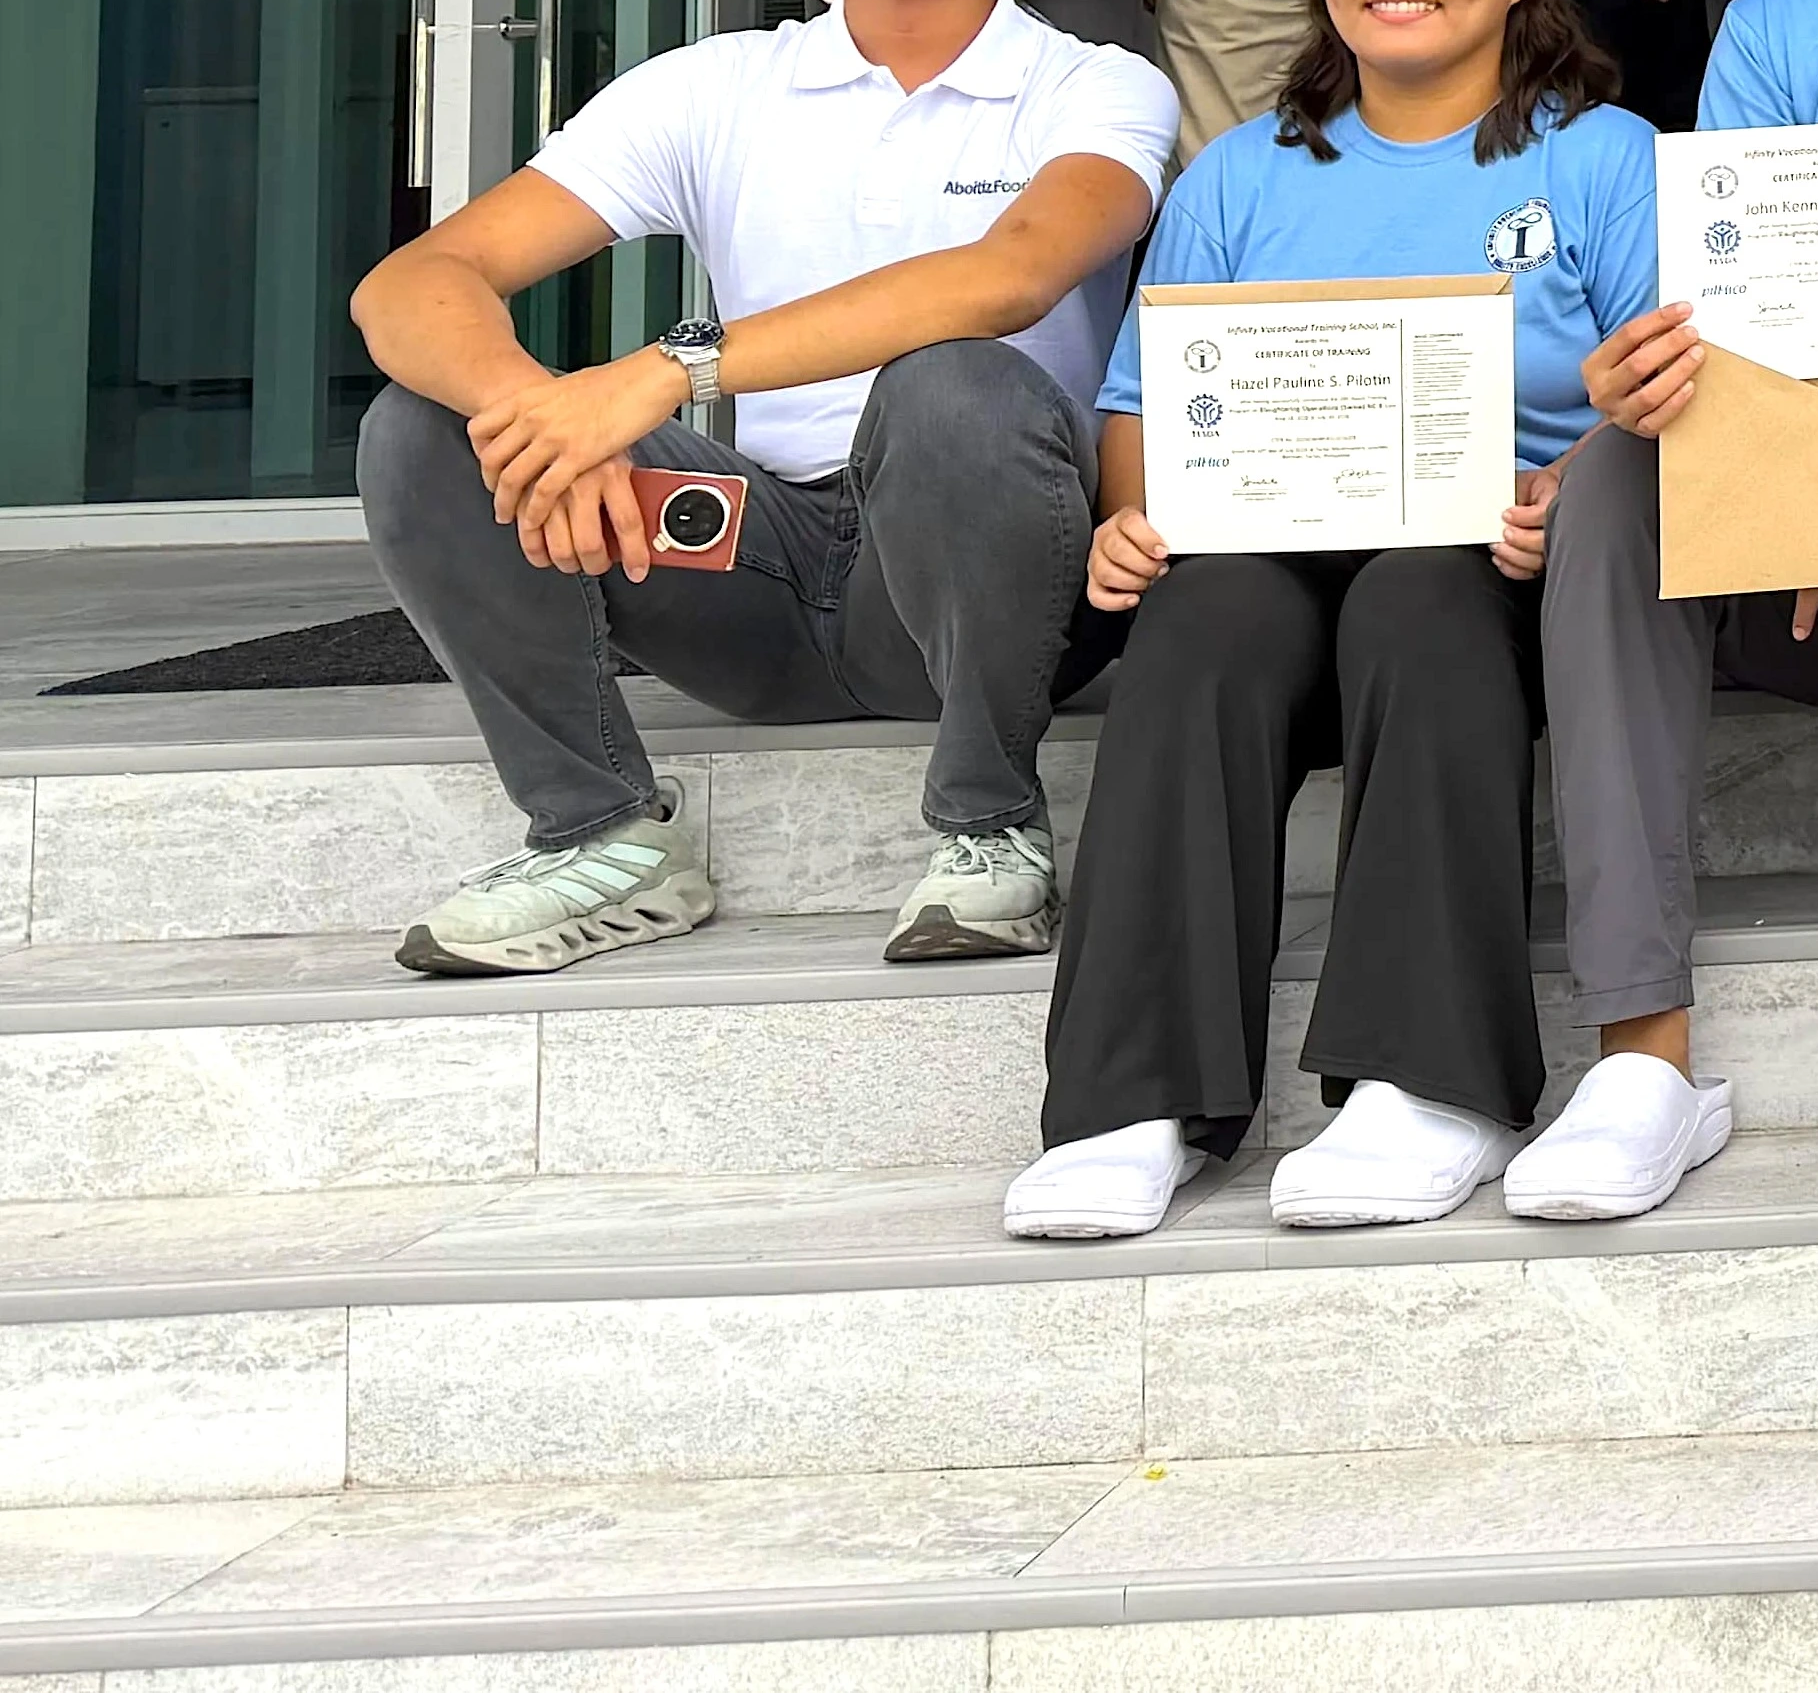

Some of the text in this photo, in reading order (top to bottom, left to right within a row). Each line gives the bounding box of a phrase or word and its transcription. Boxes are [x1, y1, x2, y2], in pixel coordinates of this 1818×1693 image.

[942, 176, 1031, 196] AboitizFoo
[1745, 202, 1778, 215] John
[1255, 347, 1371, 359] CERTIFICATE OF TRAINING
[1230, 377, 1268, 389] Hazel
[1273, 376, 1324, 389] Pauline
[1346, 373, 1391, 386] Pilotin
